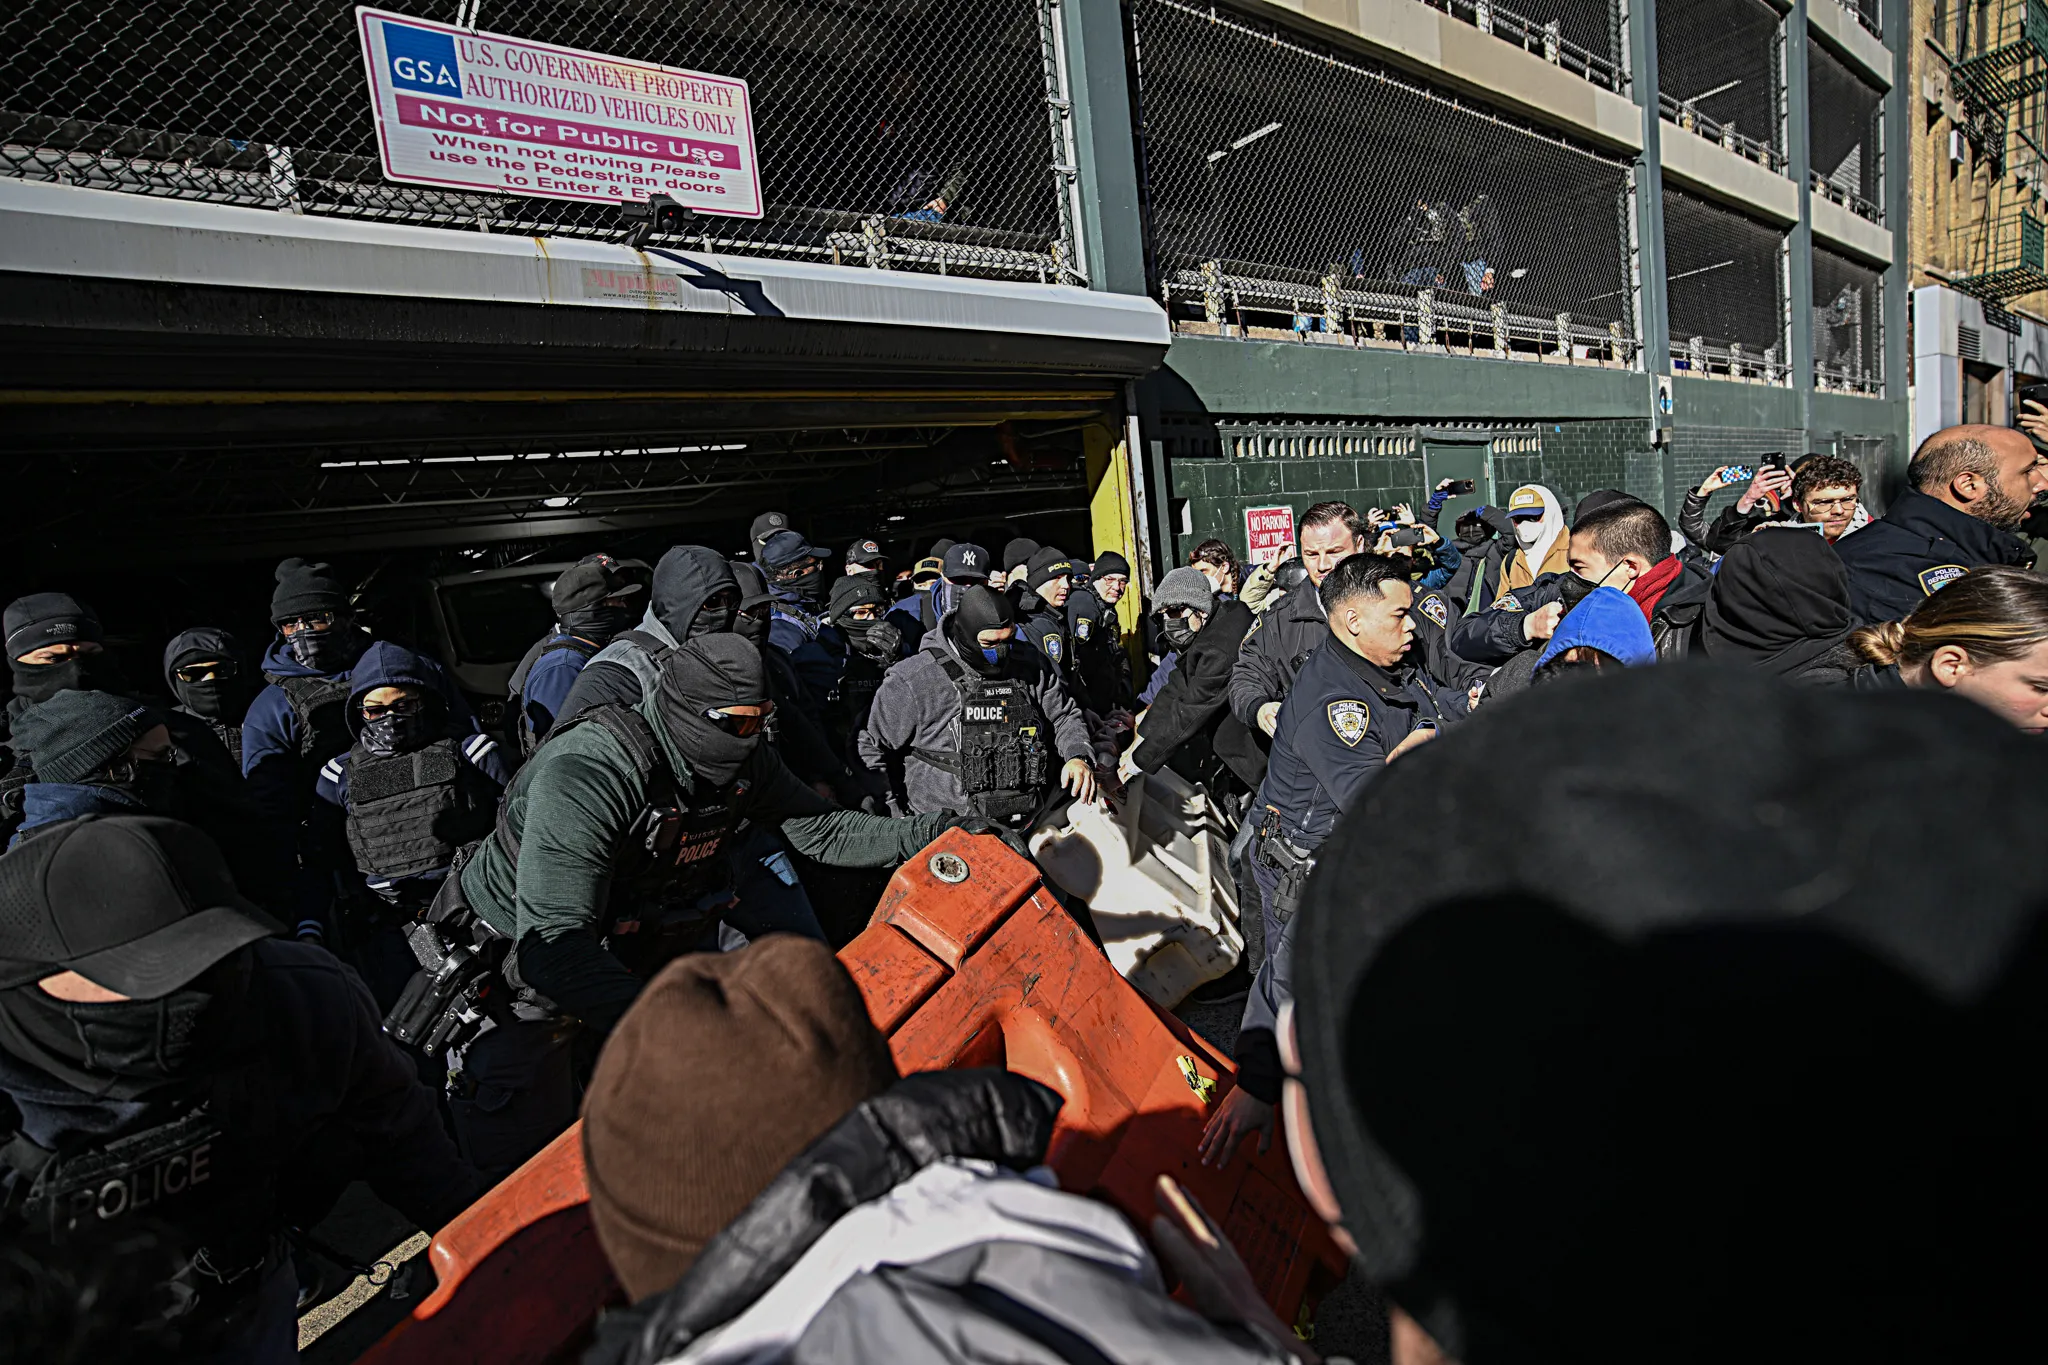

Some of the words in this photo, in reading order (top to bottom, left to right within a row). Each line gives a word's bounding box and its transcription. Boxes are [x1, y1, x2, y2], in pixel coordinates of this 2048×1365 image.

[394, 56, 458, 89] GSA
[458, 39, 500, 69] U.S.
[504, 48, 638, 92] GOVERNMENT
[643, 73, 734, 108] PROPERTY
[466, 73, 597, 115] AUTHORIZED
[600, 95, 690, 129] VEHICLES
[692, 110, 737, 136] ONLY
[419, 104, 487, 129] Not
[495, 117, 546, 137] for
[557, 125, 659, 153] Public
[668, 141, 725, 162] Use
[429, 150, 478, 165] use
[485, 156, 526, 171] the
[534, 161, 658, 187] Pedestrian
[665, 178, 727, 194] doors
[432, 133, 509, 154] When
[517, 146, 557, 161] not
[564, 152, 644, 173] driving
[650, 163, 721, 181] Please
[504, 173, 528, 186] to
[537, 177, 600, 194] Enter
[608, 185, 624, 197] &
[1251, 516, 1261, 531] NO
[1261, 515, 1291, 531] PARKING
[1259, 533, 1271, 547] ANY
[962, 550, 977, 566] NY
[1935, 568, 1960, 577] POLICE
[966, 706, 1003, 720] POLICE
[675, 838, 720, 865] POLICE
[69, 1143, 212, 1230] POLICE
